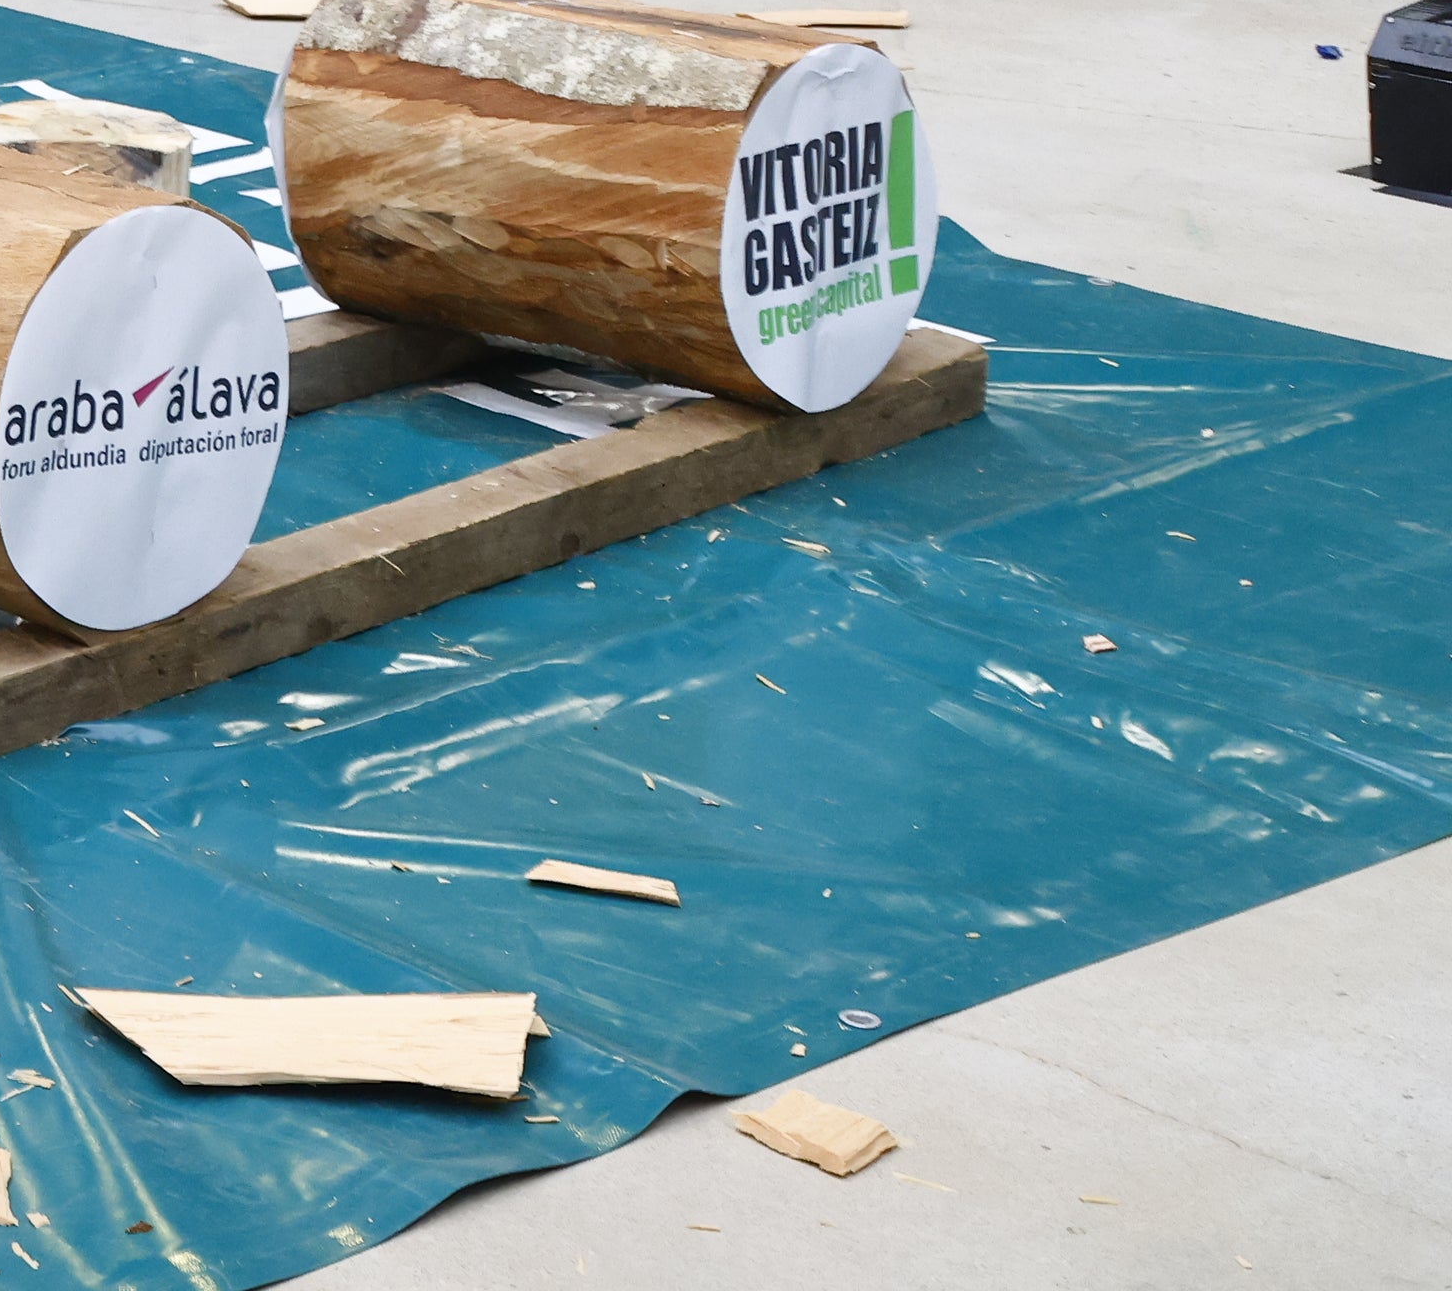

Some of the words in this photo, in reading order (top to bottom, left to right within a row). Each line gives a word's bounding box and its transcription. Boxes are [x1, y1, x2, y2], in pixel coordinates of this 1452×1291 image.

[739, 121, 884, 223] VITORIA
[744, 191, 882, 297] GASTEIZ
[1, 457, 37, 483] foru
[40, 443, 128, 474] aldundia
[138, 427, 238, 468] diputación
[239, 420, 280, 448] foral
[2, 379, 125, 448] araba
[166, 365, 282, 426] álava
